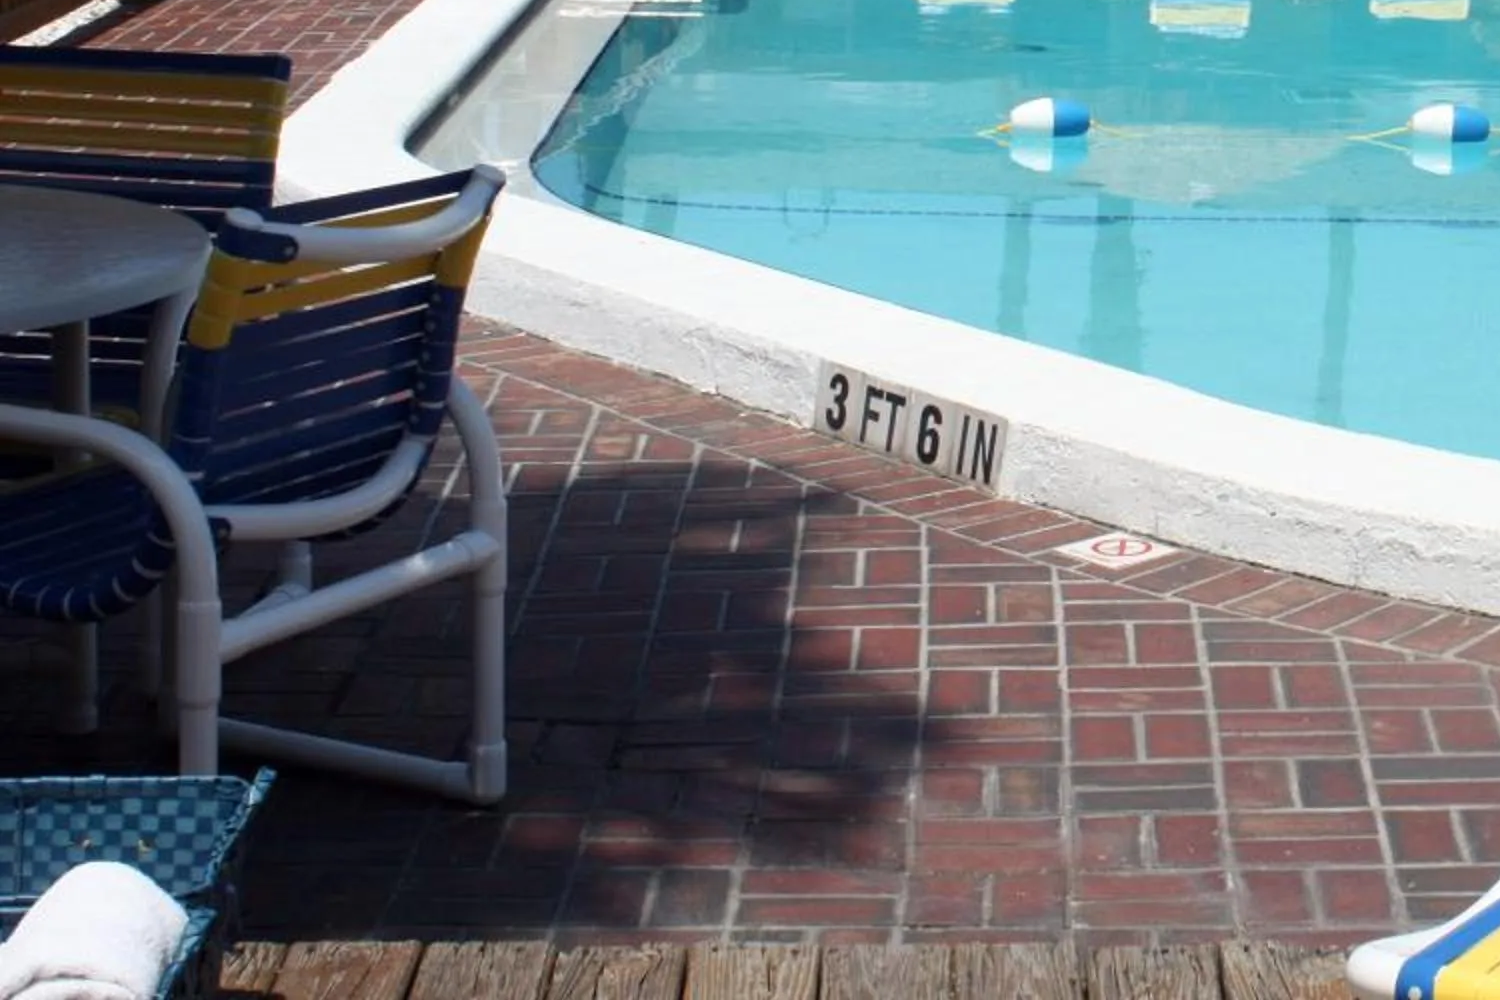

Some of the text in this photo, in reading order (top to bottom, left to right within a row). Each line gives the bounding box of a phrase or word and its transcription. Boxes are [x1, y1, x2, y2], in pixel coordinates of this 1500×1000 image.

[825, 372, 999, 485] 3 FT 6 IN
